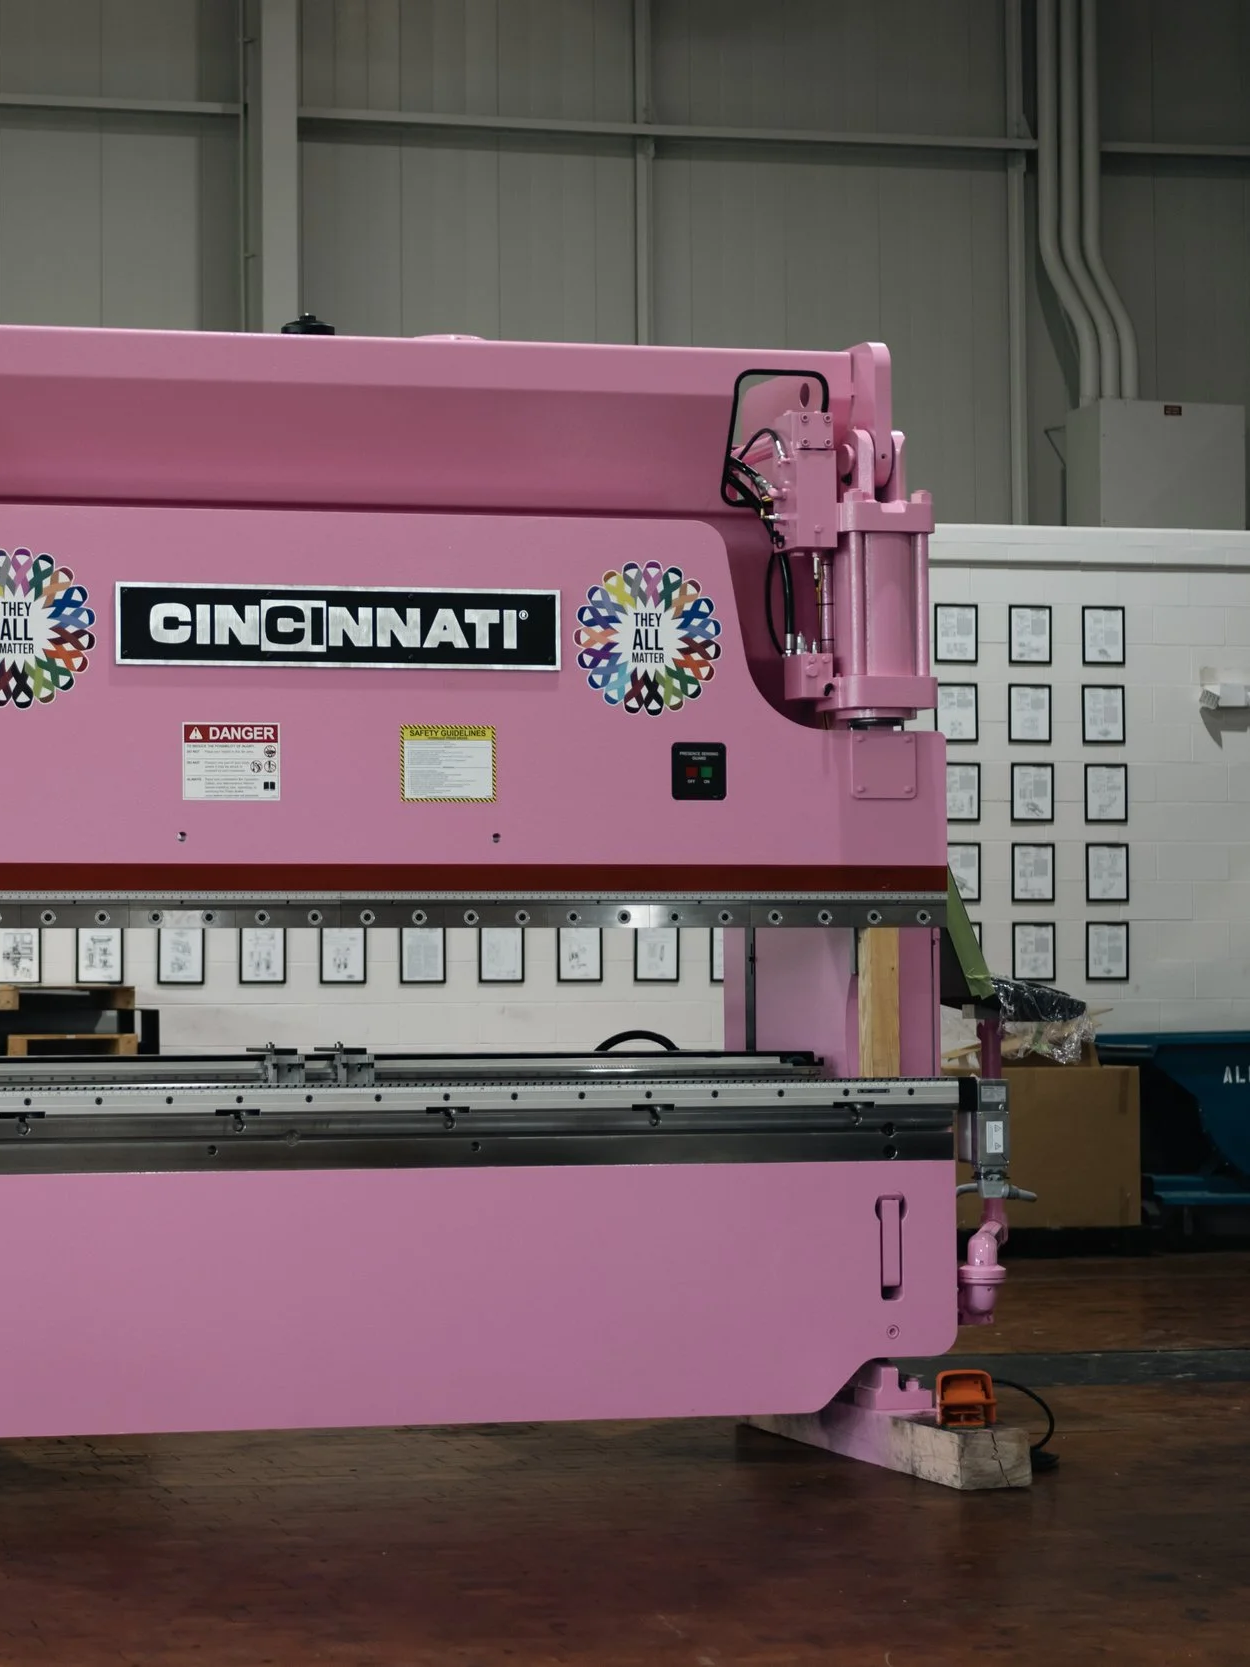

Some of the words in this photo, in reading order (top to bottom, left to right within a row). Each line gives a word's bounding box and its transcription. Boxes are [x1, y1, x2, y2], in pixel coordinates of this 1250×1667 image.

[1, 601, 32, 617] THEY
[633, 612, 662, 628] THEY
[0, 618, 34, 641] ALL
[632, 628, 664, 651] ALL
[0, 643, 34, 654] MATTER
[631, 652, 665, 664] MATTER
[209, 726, 275, 740] DANGER
[409, 729, 439, 737] SAFETY
[440, 729, 486, 737] GUIDELINES
[1223, 1065, 1250, 1083] AL
